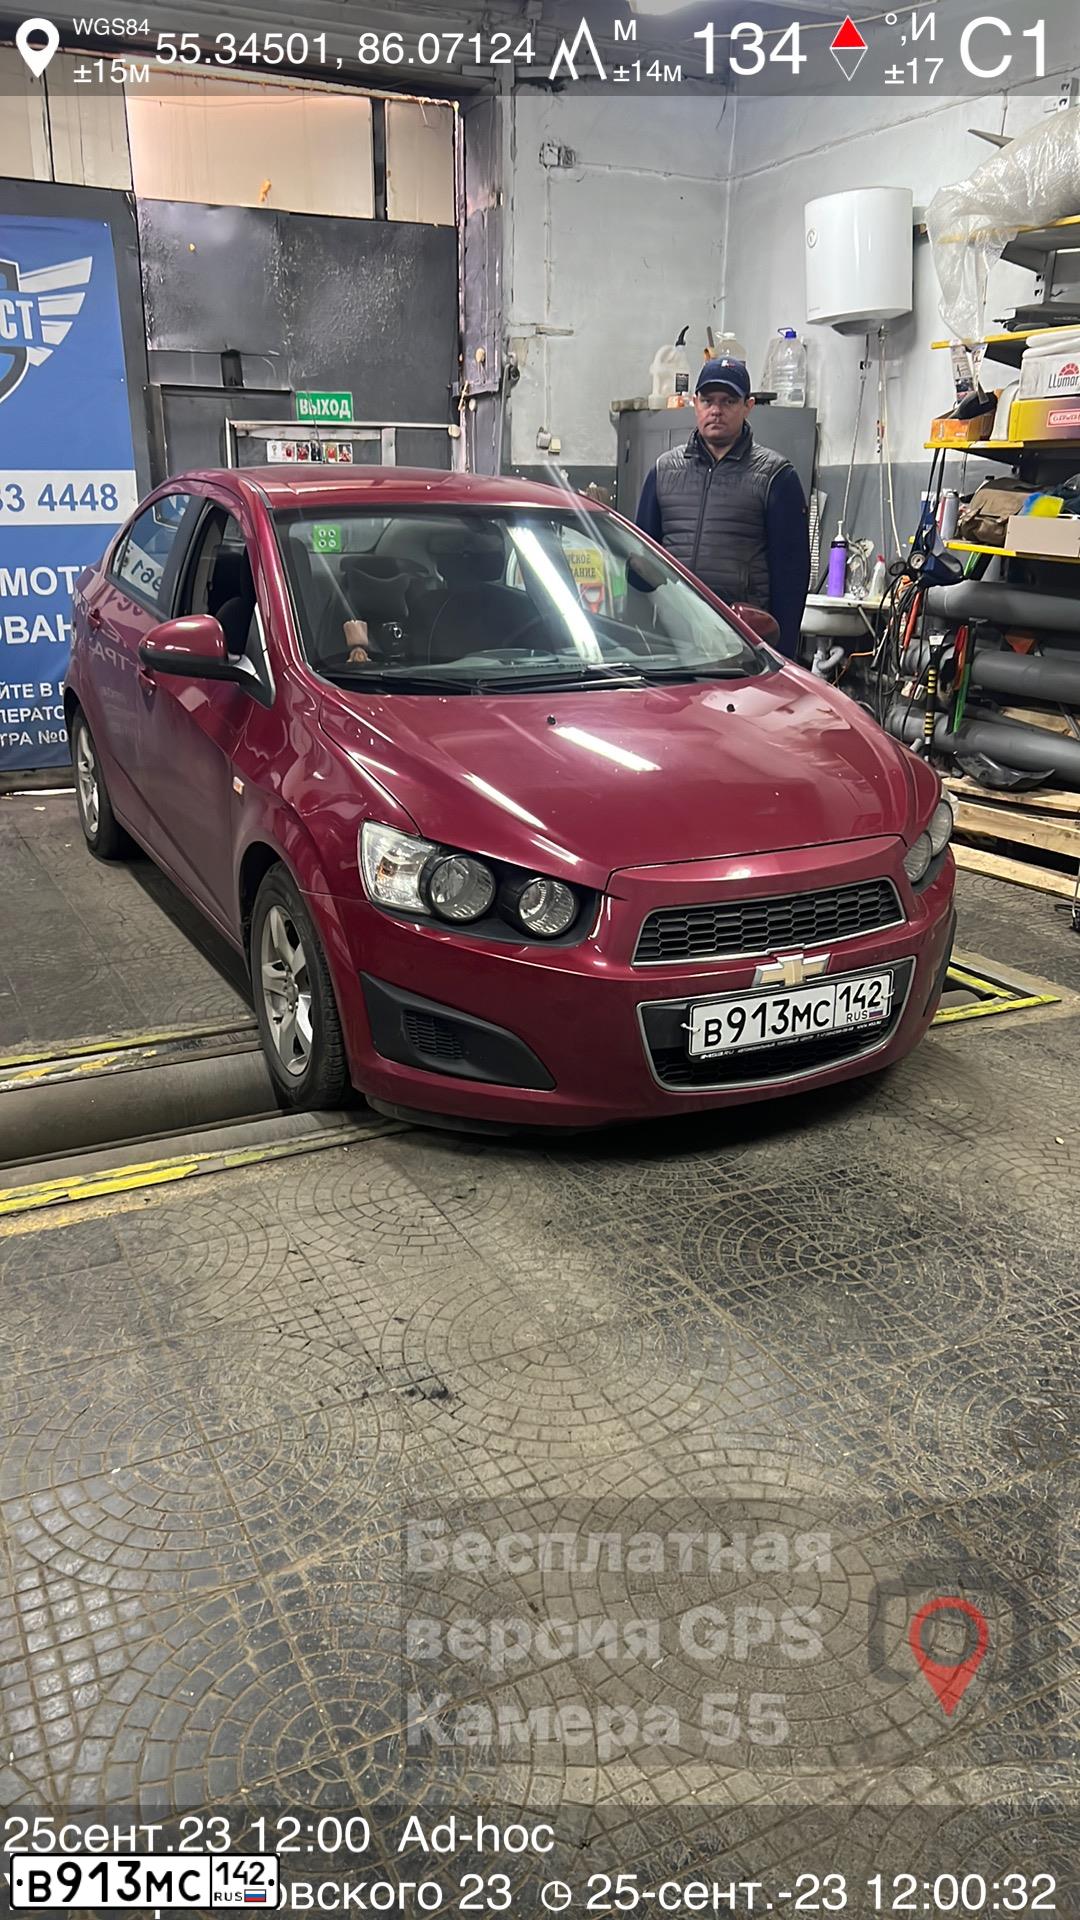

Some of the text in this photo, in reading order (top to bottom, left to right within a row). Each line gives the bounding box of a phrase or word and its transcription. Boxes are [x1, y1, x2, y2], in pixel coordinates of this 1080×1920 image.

[299, 398, 351, 418] ВЫХОД
[38, 483, 119, 511] 4448
[0, 565, 87, 597] МОТ
[704, 980, 883, 1048] В913МС 142
[846, 1010, 868, 1023] RUS
